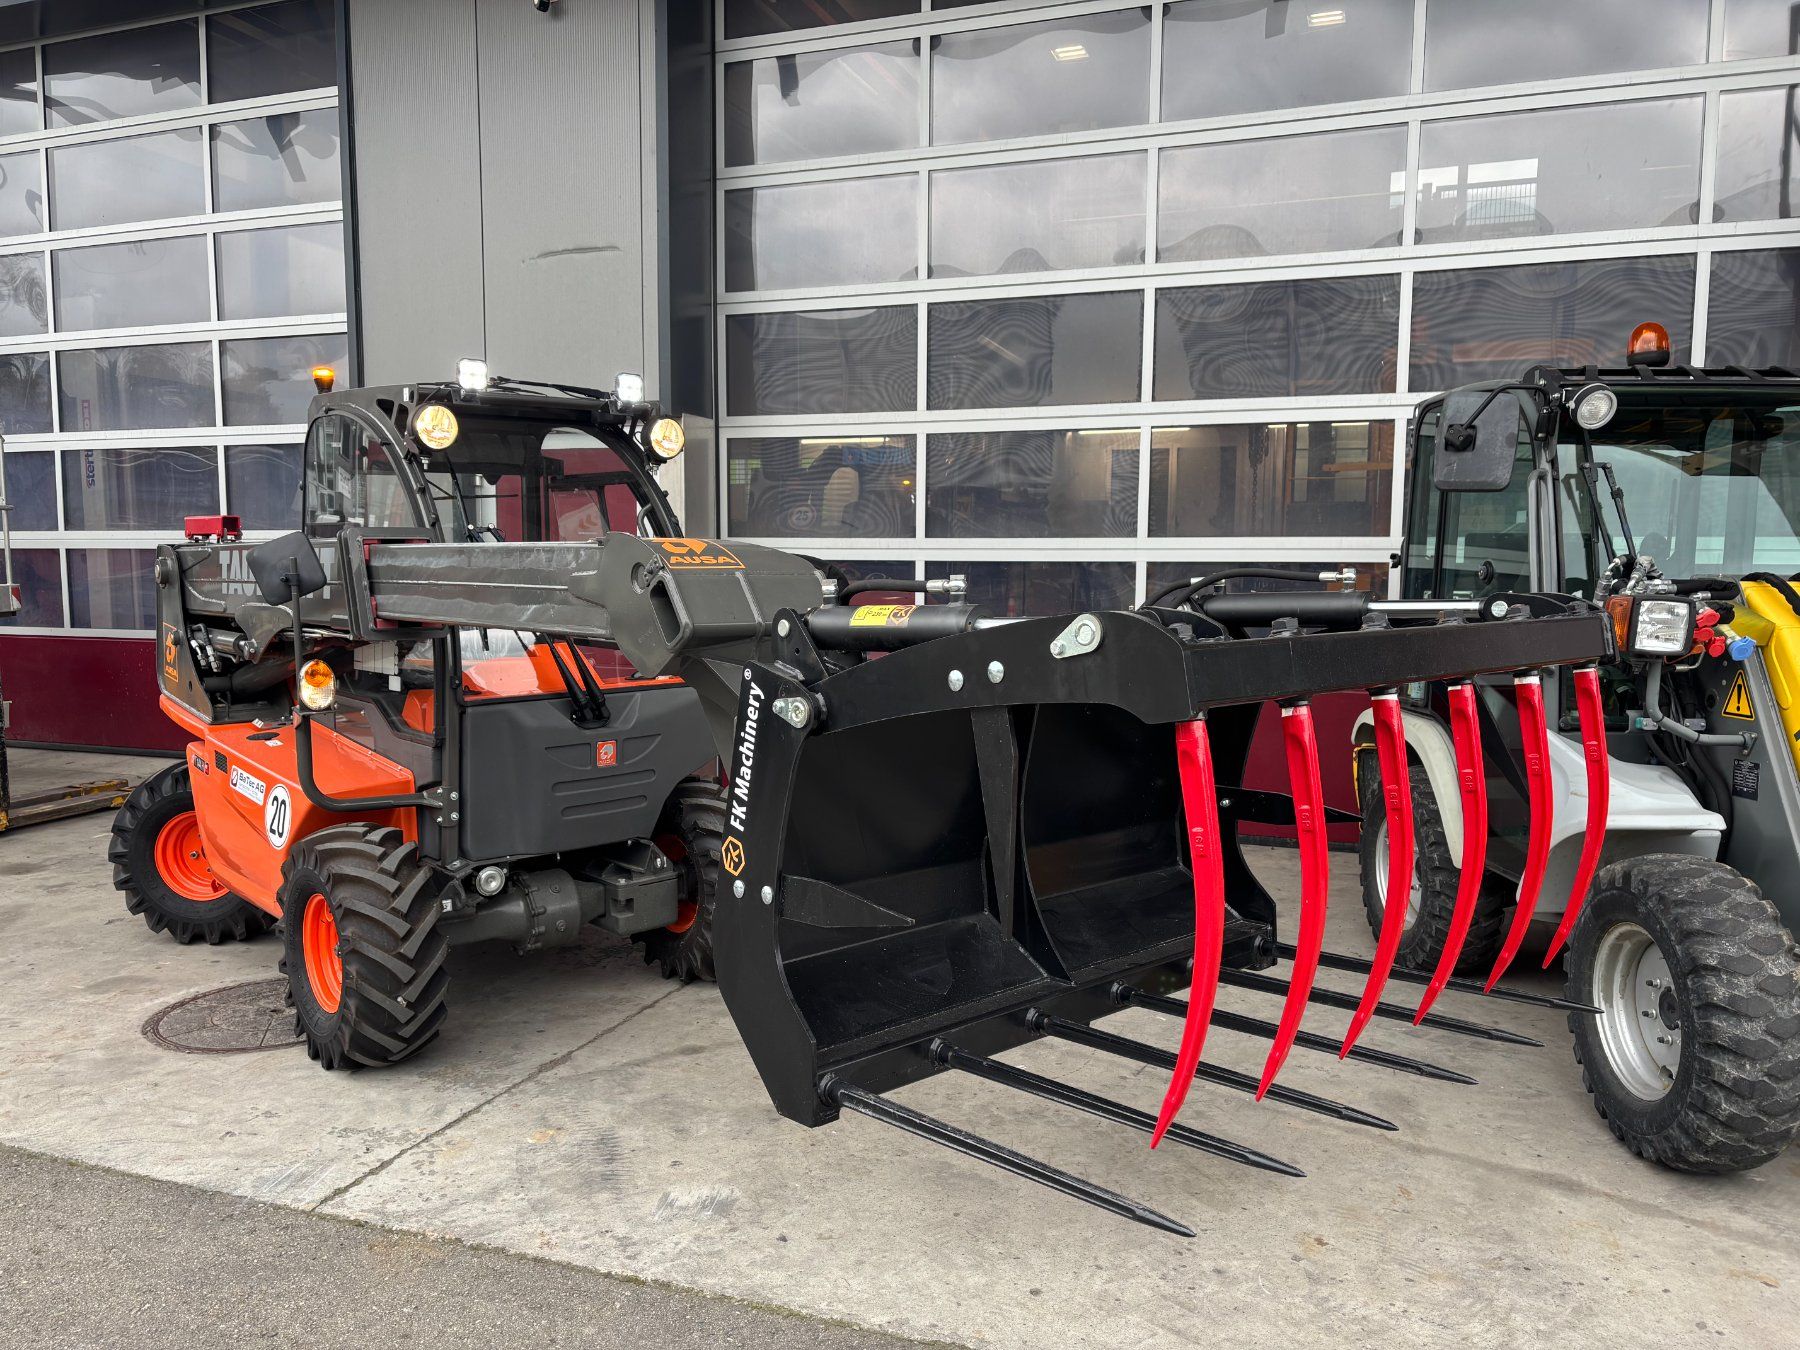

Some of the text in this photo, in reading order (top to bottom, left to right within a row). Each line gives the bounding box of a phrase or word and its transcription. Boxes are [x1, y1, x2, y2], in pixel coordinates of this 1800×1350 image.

[670, 555, 738, 564] AUSA
[239, 772, 255, 789] BaTec
[255, 783, 264, 794] AG
[269, 795, 287, 838] 20
[730, 800, 747, 832] FK
